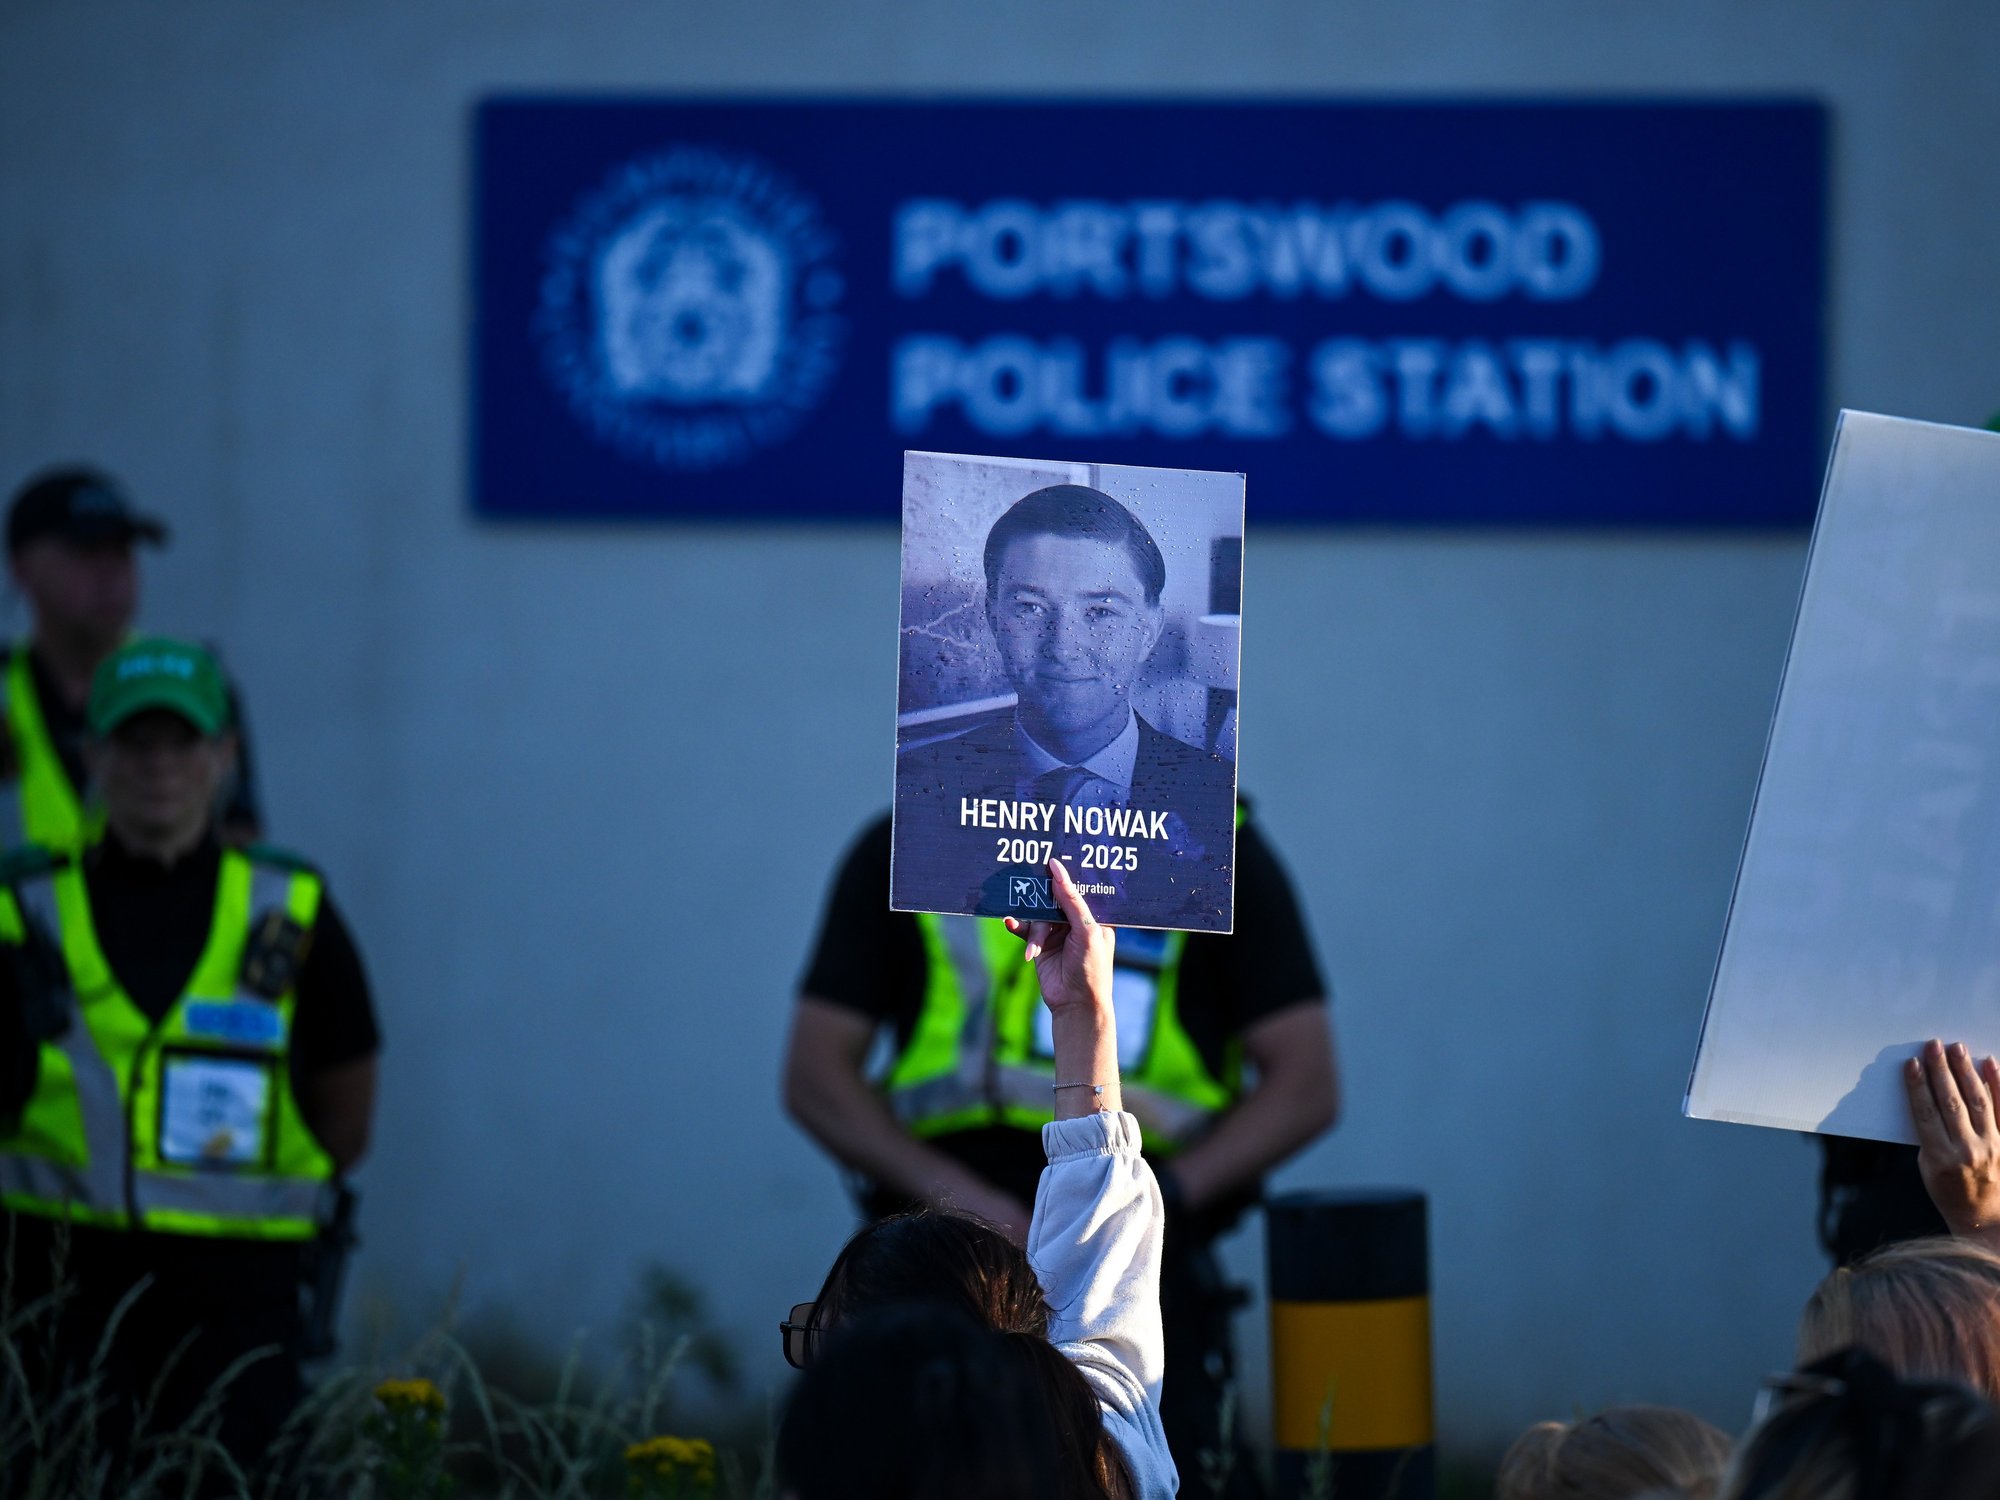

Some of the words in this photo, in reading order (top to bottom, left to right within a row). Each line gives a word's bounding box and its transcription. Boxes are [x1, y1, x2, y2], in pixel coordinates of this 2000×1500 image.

[896, 202, 1597, 297] PORTSWOOD
[894, 337, 1281, 435] POLICE
[1313, 340, 1756, 436] STATION
[961, 798, 1056, 832] HENRY
[1064, 805, 1169, 840] NOWAK
[996, 838, 1053, 866] 2007
[1080, 844, 1138, 871] 2025
[1072, 881, 1115, 896] igration
